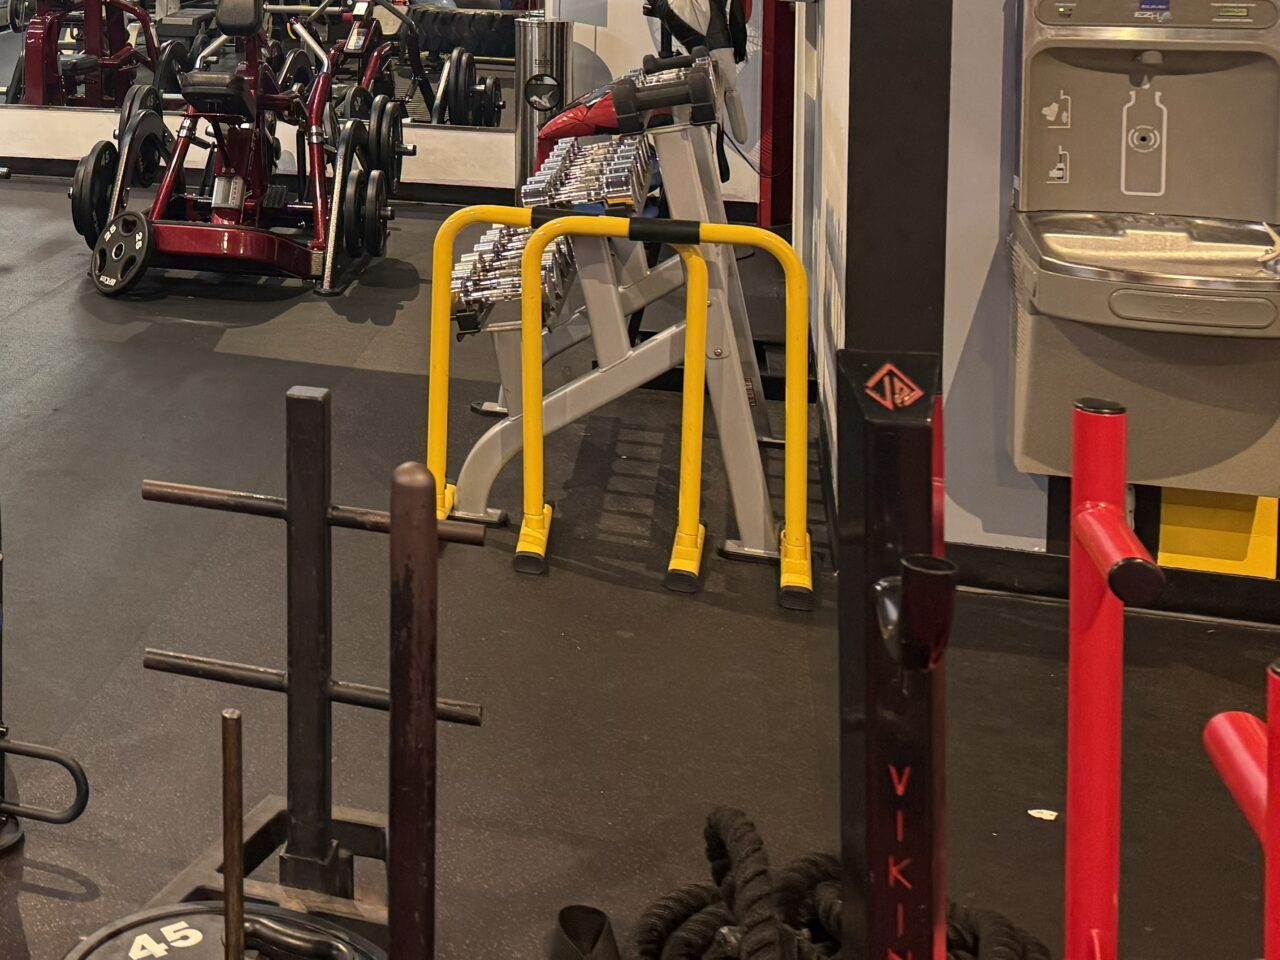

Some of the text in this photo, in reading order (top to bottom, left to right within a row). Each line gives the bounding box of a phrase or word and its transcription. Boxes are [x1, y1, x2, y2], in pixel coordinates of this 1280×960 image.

[104, 224, 117, 241] 25
[135, 232, 142, 250] 25
[128, 921, 203, 960] 45
